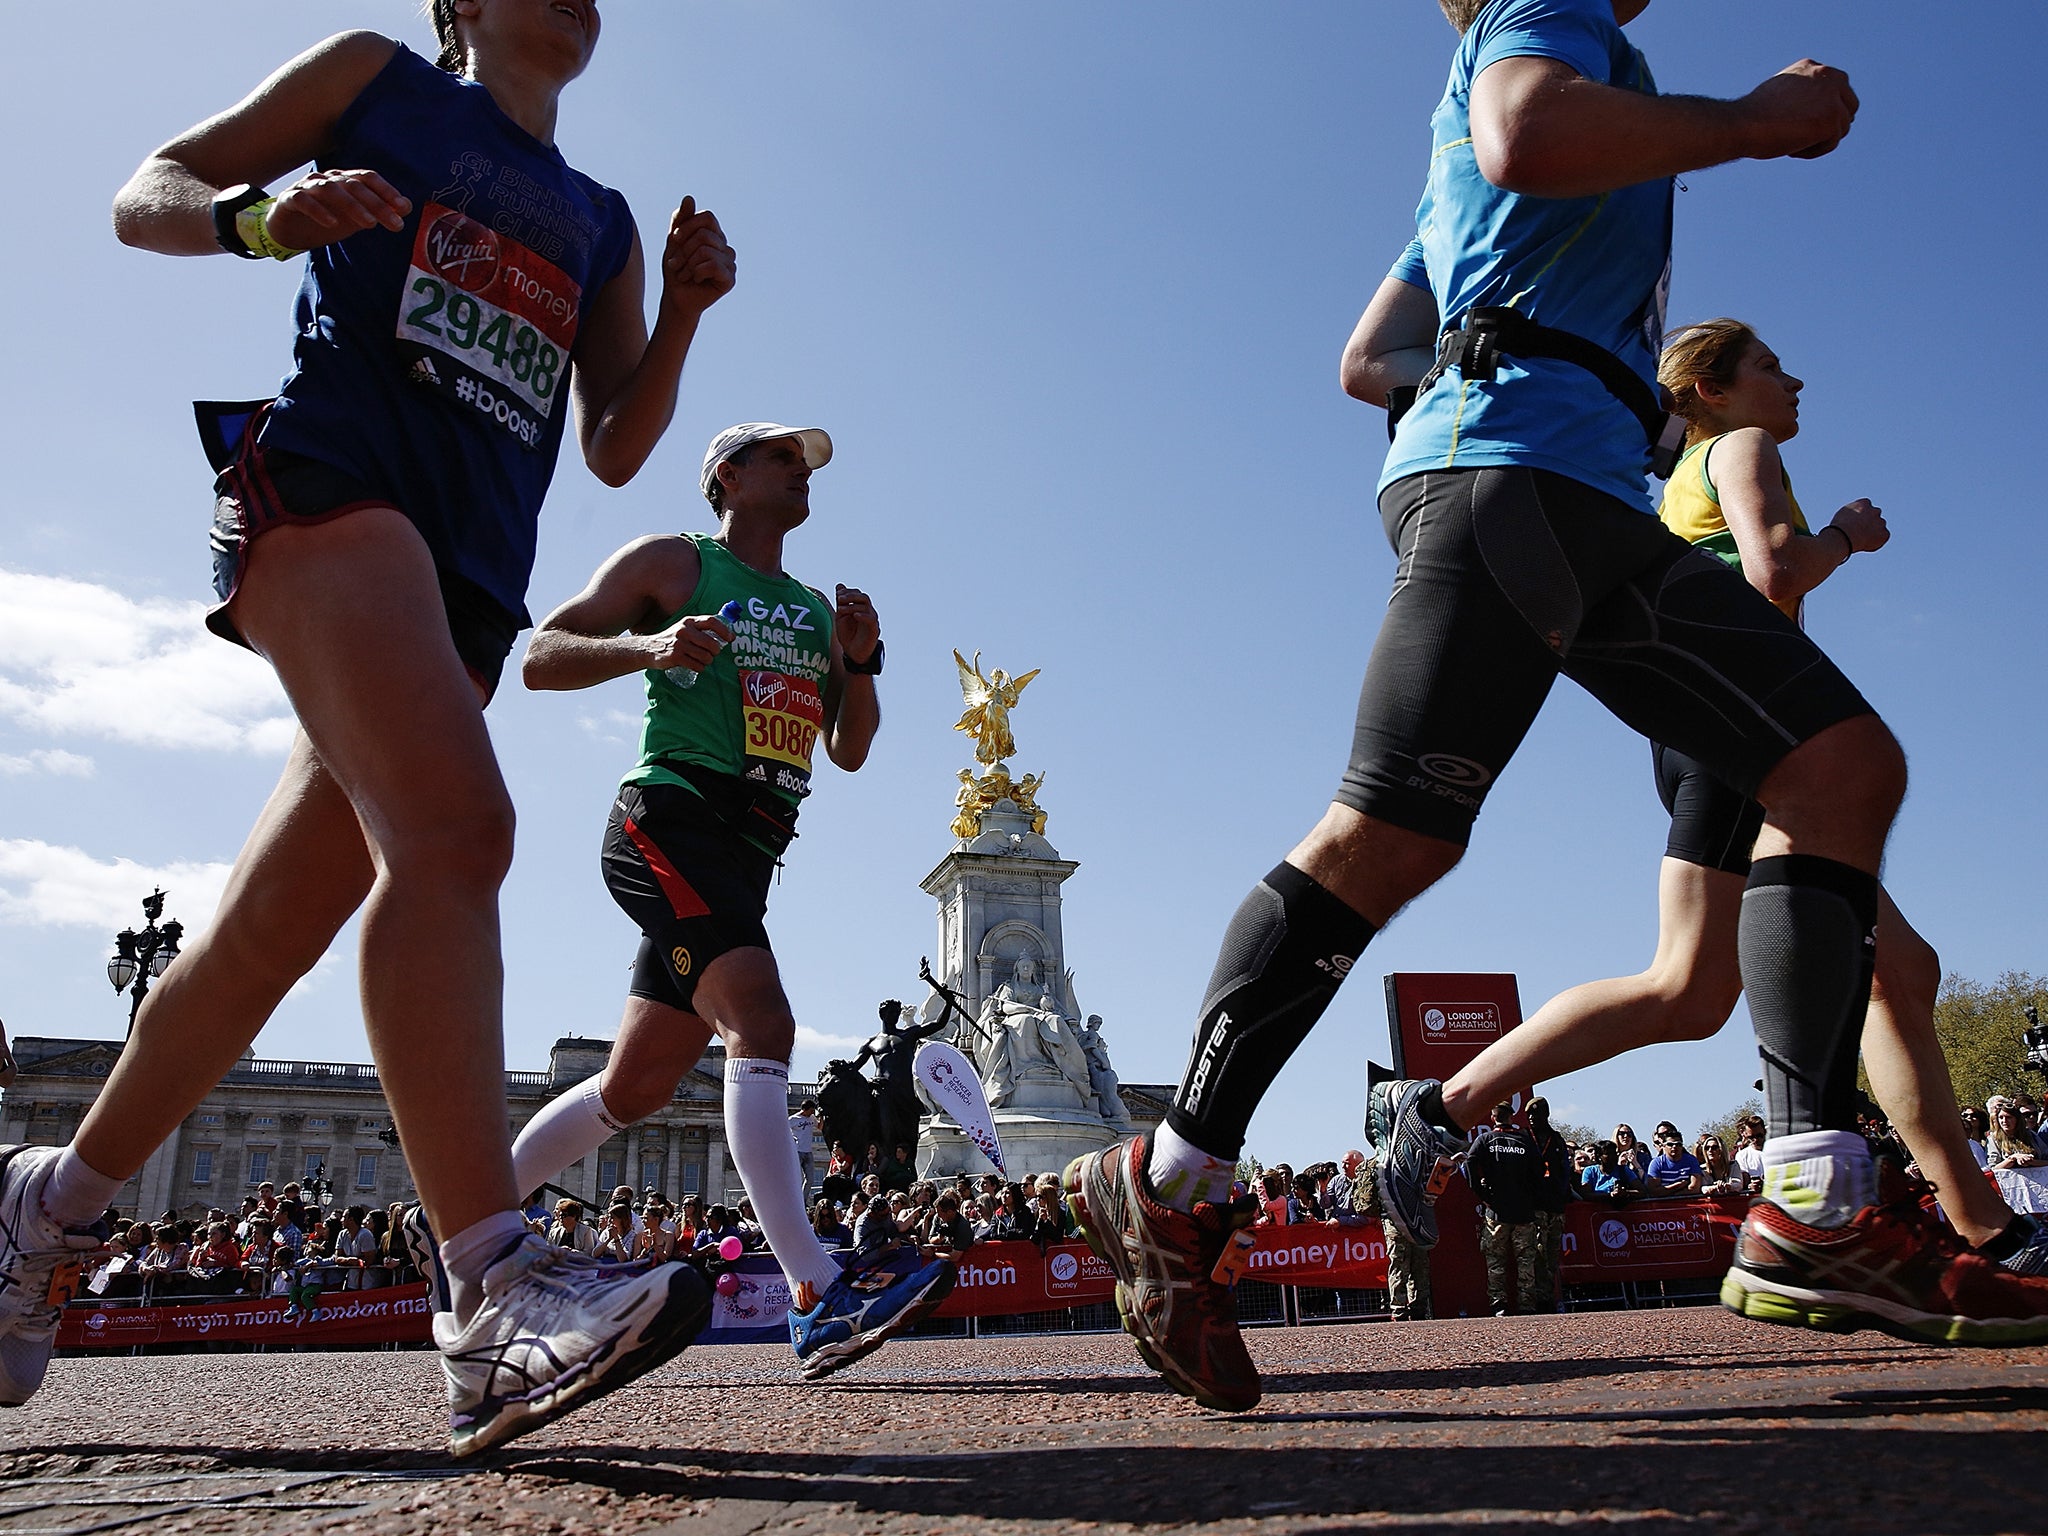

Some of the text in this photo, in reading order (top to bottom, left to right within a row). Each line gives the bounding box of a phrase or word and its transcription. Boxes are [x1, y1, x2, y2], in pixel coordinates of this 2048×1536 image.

[498, 165, 601, 243] BENTLEY
[487, 181, 594, 257] RUNNING
[492, 209, 566, 261] CLUB
[431, 217, 577, 327] Virgin money
[405, 276, 559, 400] 29488
[455, 376, 538, 446] #boost
[747, 597, 815, 631] GAZ
[732, 620, 796, 646] WE ARE
[731, 635, 831, 674] MACMILLAN
[750, 673, 785, 708] Virgin
[776, 769, 809, 794] #boo
[1405, 775, 1481, 810] BV SPORT
[1447, 1012, 1484, 1020] LONDON
[1448, 1020, 1497, 1029] MARATHON
[1185, 1010, 1233, 1116] BOOSTER
[948, 1080, 972, 1107] RESEARCH
[952, 1075, 972, 1098] CANCER
[1489, 1145, 1526, 1155] STEWARD
[1602, 1224, 1626, 1244] Virgin
[1632, 1220, 1687, 1233] LONDON
[1634, 1231, 1706, 1244] MARATHON
[1053, 1257, 1076, 1276] Virgin
[1081, 1256, 1109, 1265] LON
[1249, 1243, 1338, 1269] money
[1602, 1250, 1631, 1258] money
[953, 1263, 1016, 1288] thon
[171, 1312, 230, 1334] virgin
[319, 1300, 389, 1321] ondon
[763, 1306, 778, 1315] UK
